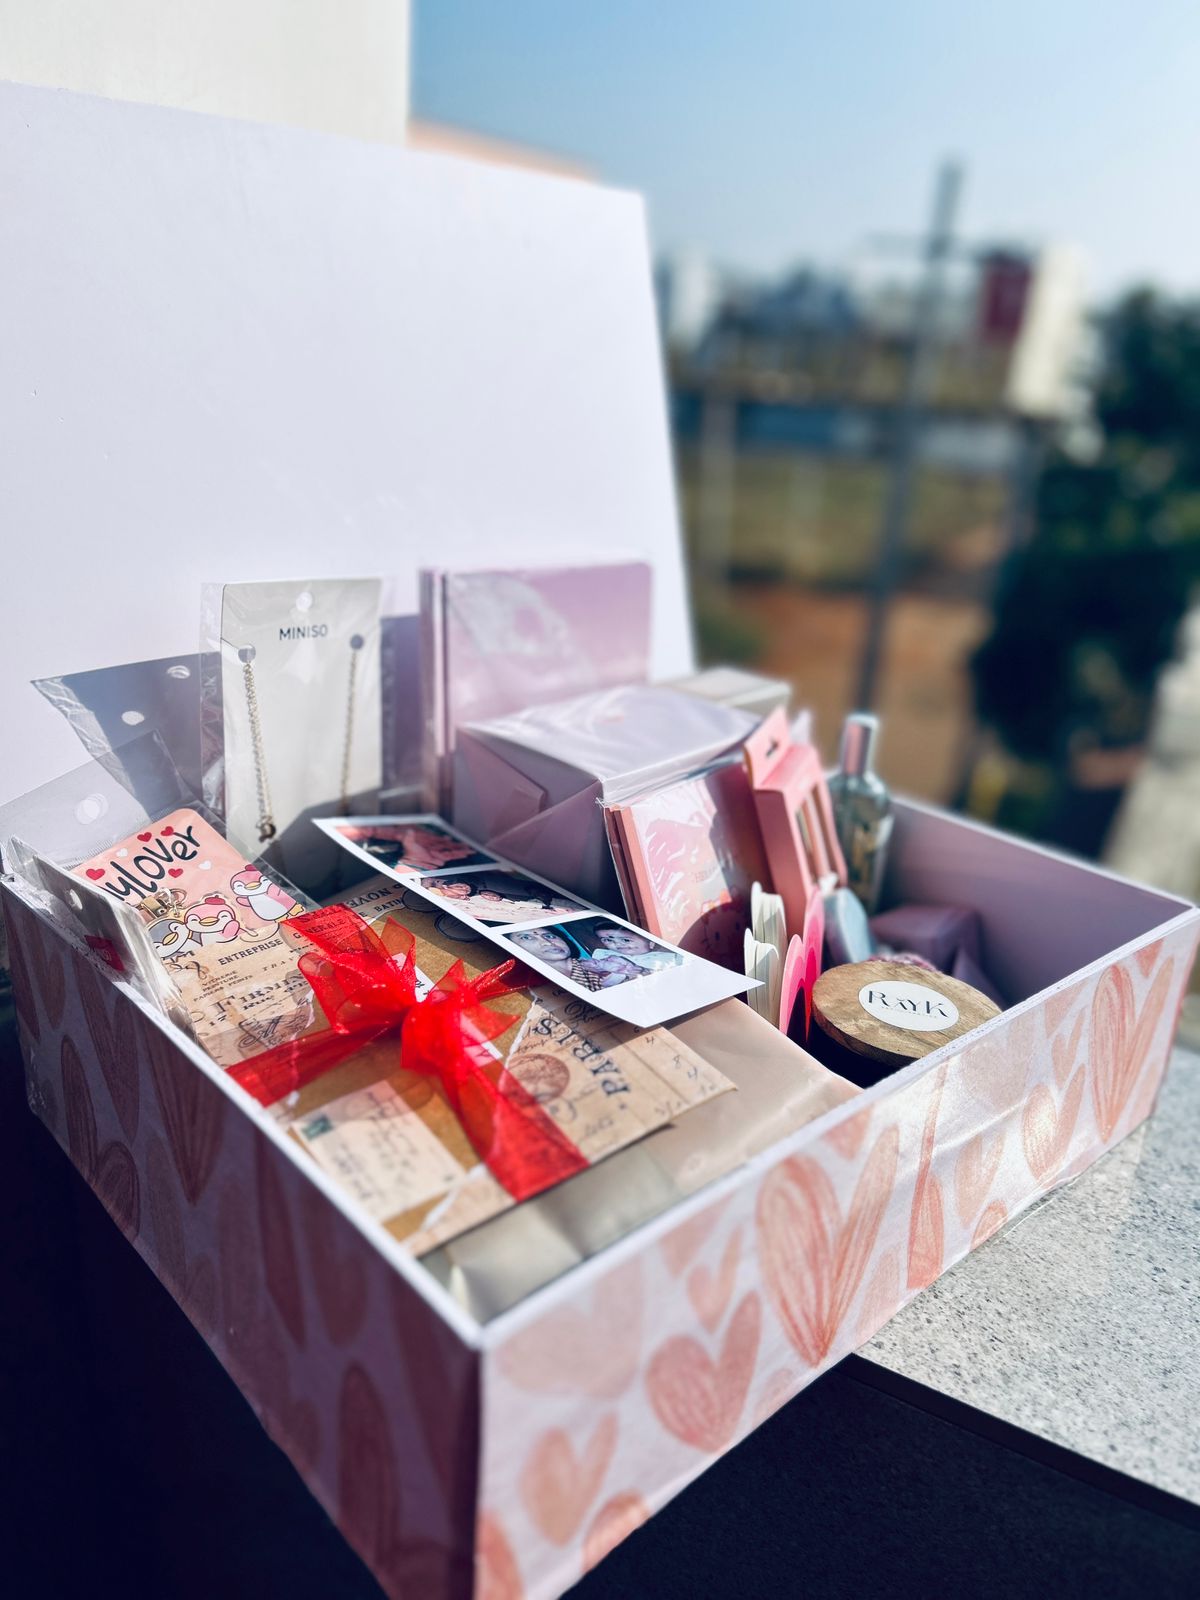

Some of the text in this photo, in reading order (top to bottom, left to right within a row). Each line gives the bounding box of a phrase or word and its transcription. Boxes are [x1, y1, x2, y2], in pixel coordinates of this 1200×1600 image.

[279, 624, 328, 641] MINISO
[217, 938, 284, 966] ENTREPRISE
[532, 1018, 630, 1096] PARIS
